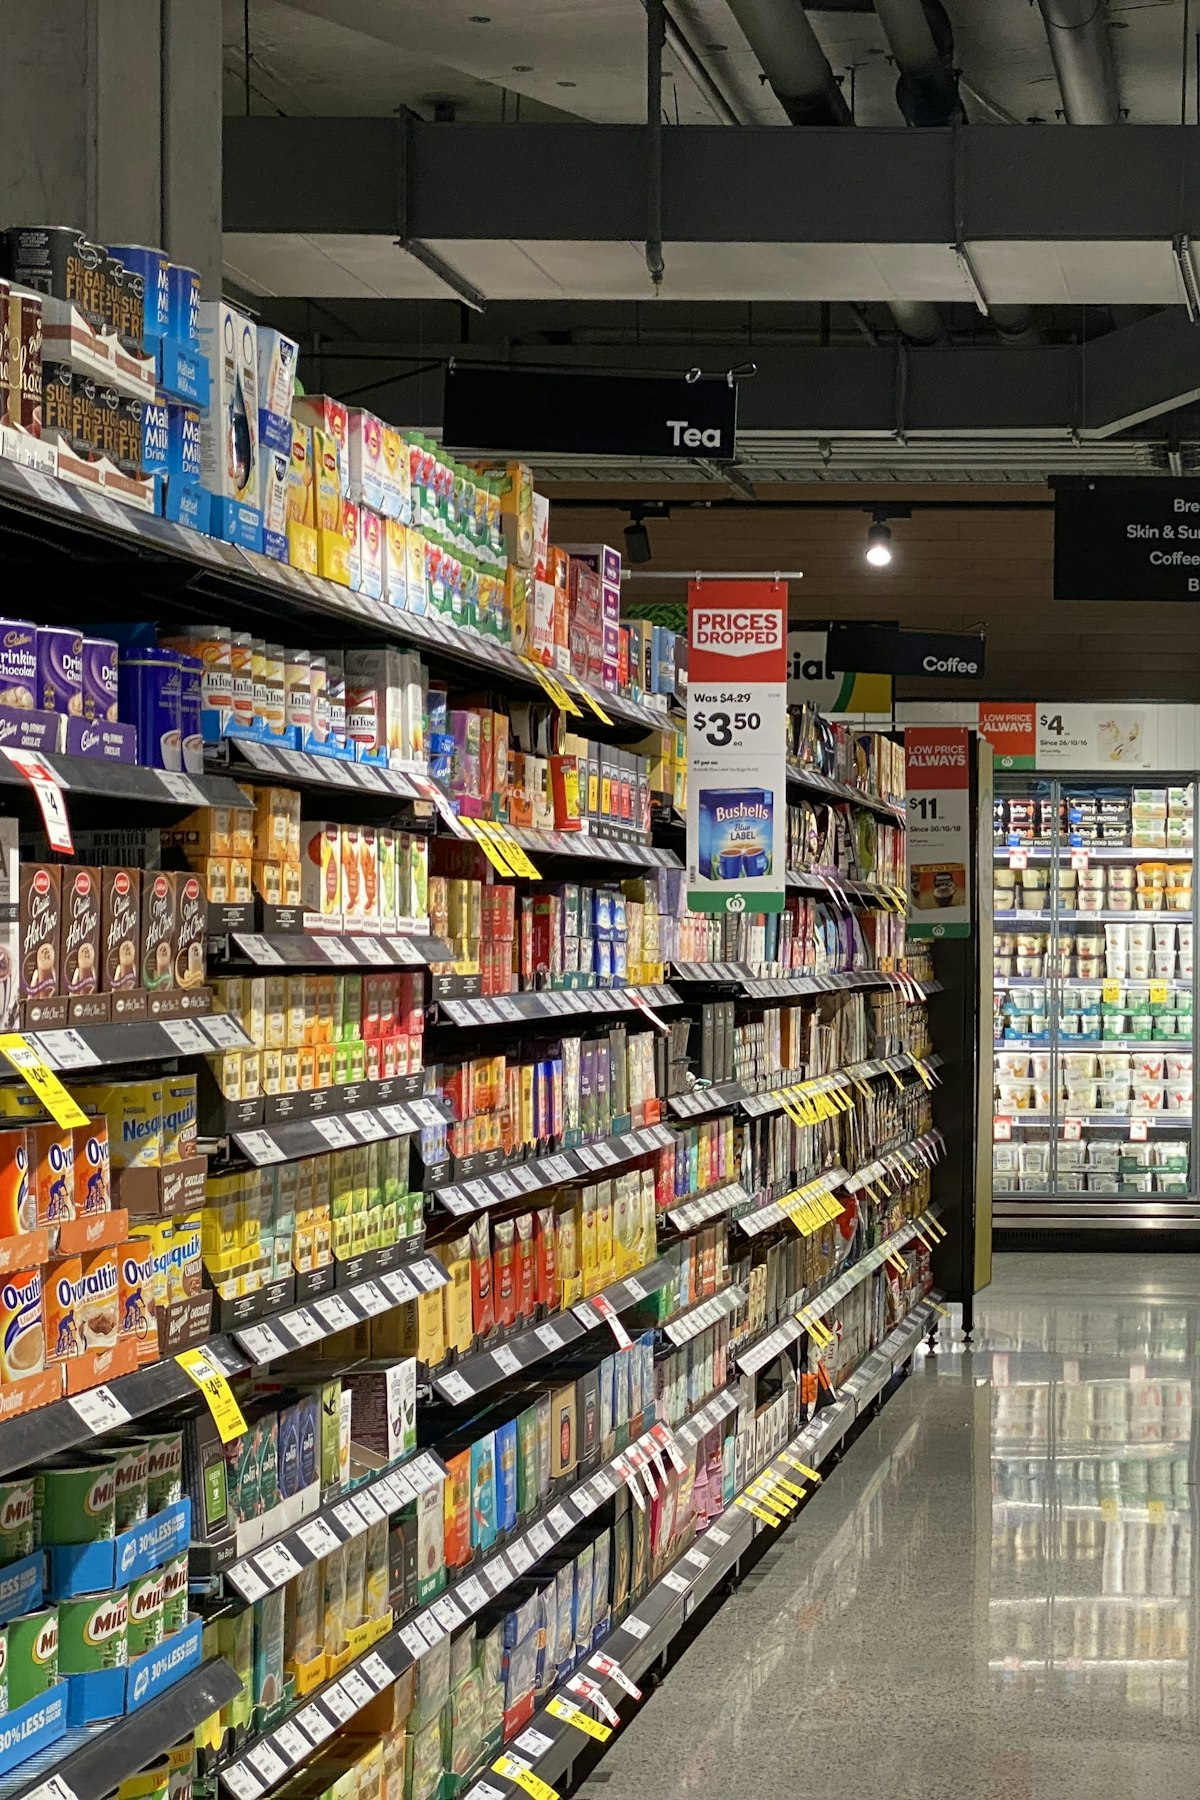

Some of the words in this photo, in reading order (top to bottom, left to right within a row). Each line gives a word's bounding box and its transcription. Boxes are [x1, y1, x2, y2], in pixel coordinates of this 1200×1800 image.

[666, 420, 722, 451] Tea
[1126, 525, 1159, 539] Skin
[1163, 526, 1175, 539] &
[1149, 551, 1200, 566] Coffee
[697, 613, 778, 631] PRICES
[697, 631, 778, 644] DROPPED
[922, 655, 978, 674] Coffee
[693, 693, 718, 703] Was
[720, 692, 751, 704] $4.29
[983, 714, 1011, 722] LOW
[1011, 714, 1032, 722] PRICE
[1040, 714, 1065, 736] $4
[983, 722, 1032, 733] ALWAYS
[909, 745, 934, 755] LOW
[935, 745, 966, 755] PRICE
[908, 755, 966, 767] ALWAYS
[715, 803, 769, 822] Bushells
[909, 797, 938, 820] $11
[734, 823, 751, 832] Blue
[909, 825, 928, 833] Since
[730, 831, 756, 841] LABEL
[154, 1519, 172, 1546] LESS
[167, 1647, 186, 1673] LESS
[21, 1711, 46, 1740] LESS
